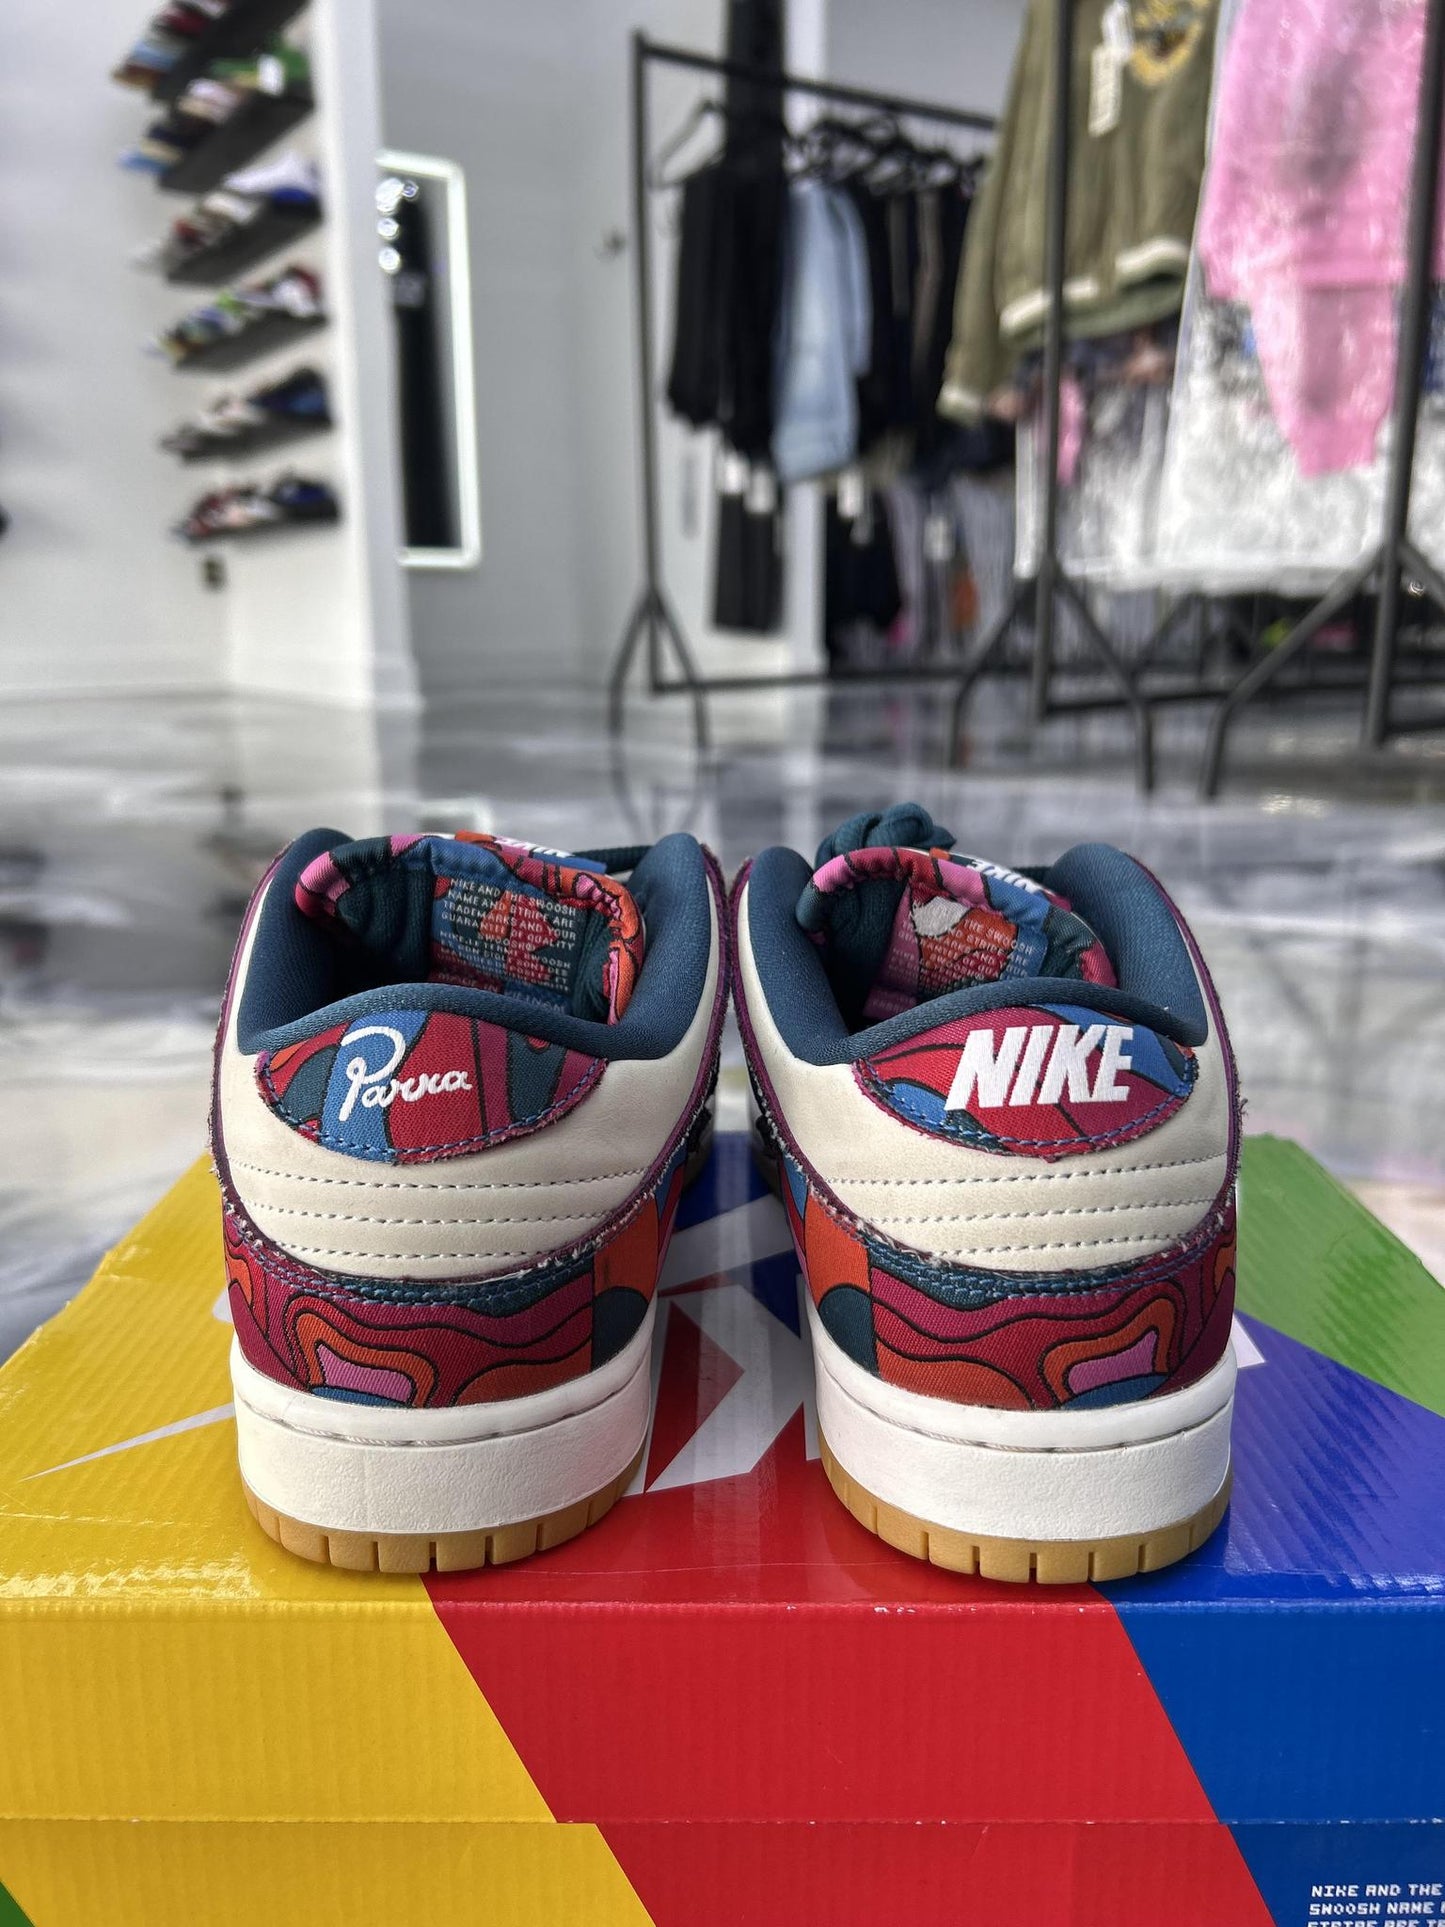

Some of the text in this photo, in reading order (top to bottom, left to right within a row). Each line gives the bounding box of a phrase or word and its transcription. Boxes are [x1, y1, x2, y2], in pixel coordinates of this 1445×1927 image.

[448, 889, 577, 928] NAME AND STRIPE ARE
[450, 879, 576, 916] NIKE AND THE SWOOSH
[441, 911, 575, 951] GUARANTEE OF QUALITY
[443, 899, 576, 941] TRADEMARKS AND YOUR
[964, 920, 984, 933] THE
[985, 926, 1034, 955] SWOOSH
[966, 934, 1005, 956] STRIPE
[1007, 952, 1029, 967] ARE
[972, 949, 996, 966] AND
[339, 1026, 473, 1121] Parra
[944, 1024, 1134, 1110] NIKE
[1309, 1903, 1381, 1915] SWOOSH
[1387, 1902, 1435, 1914] NAME
[1311, 1883, 1443, 1897] NIKE AND THE
